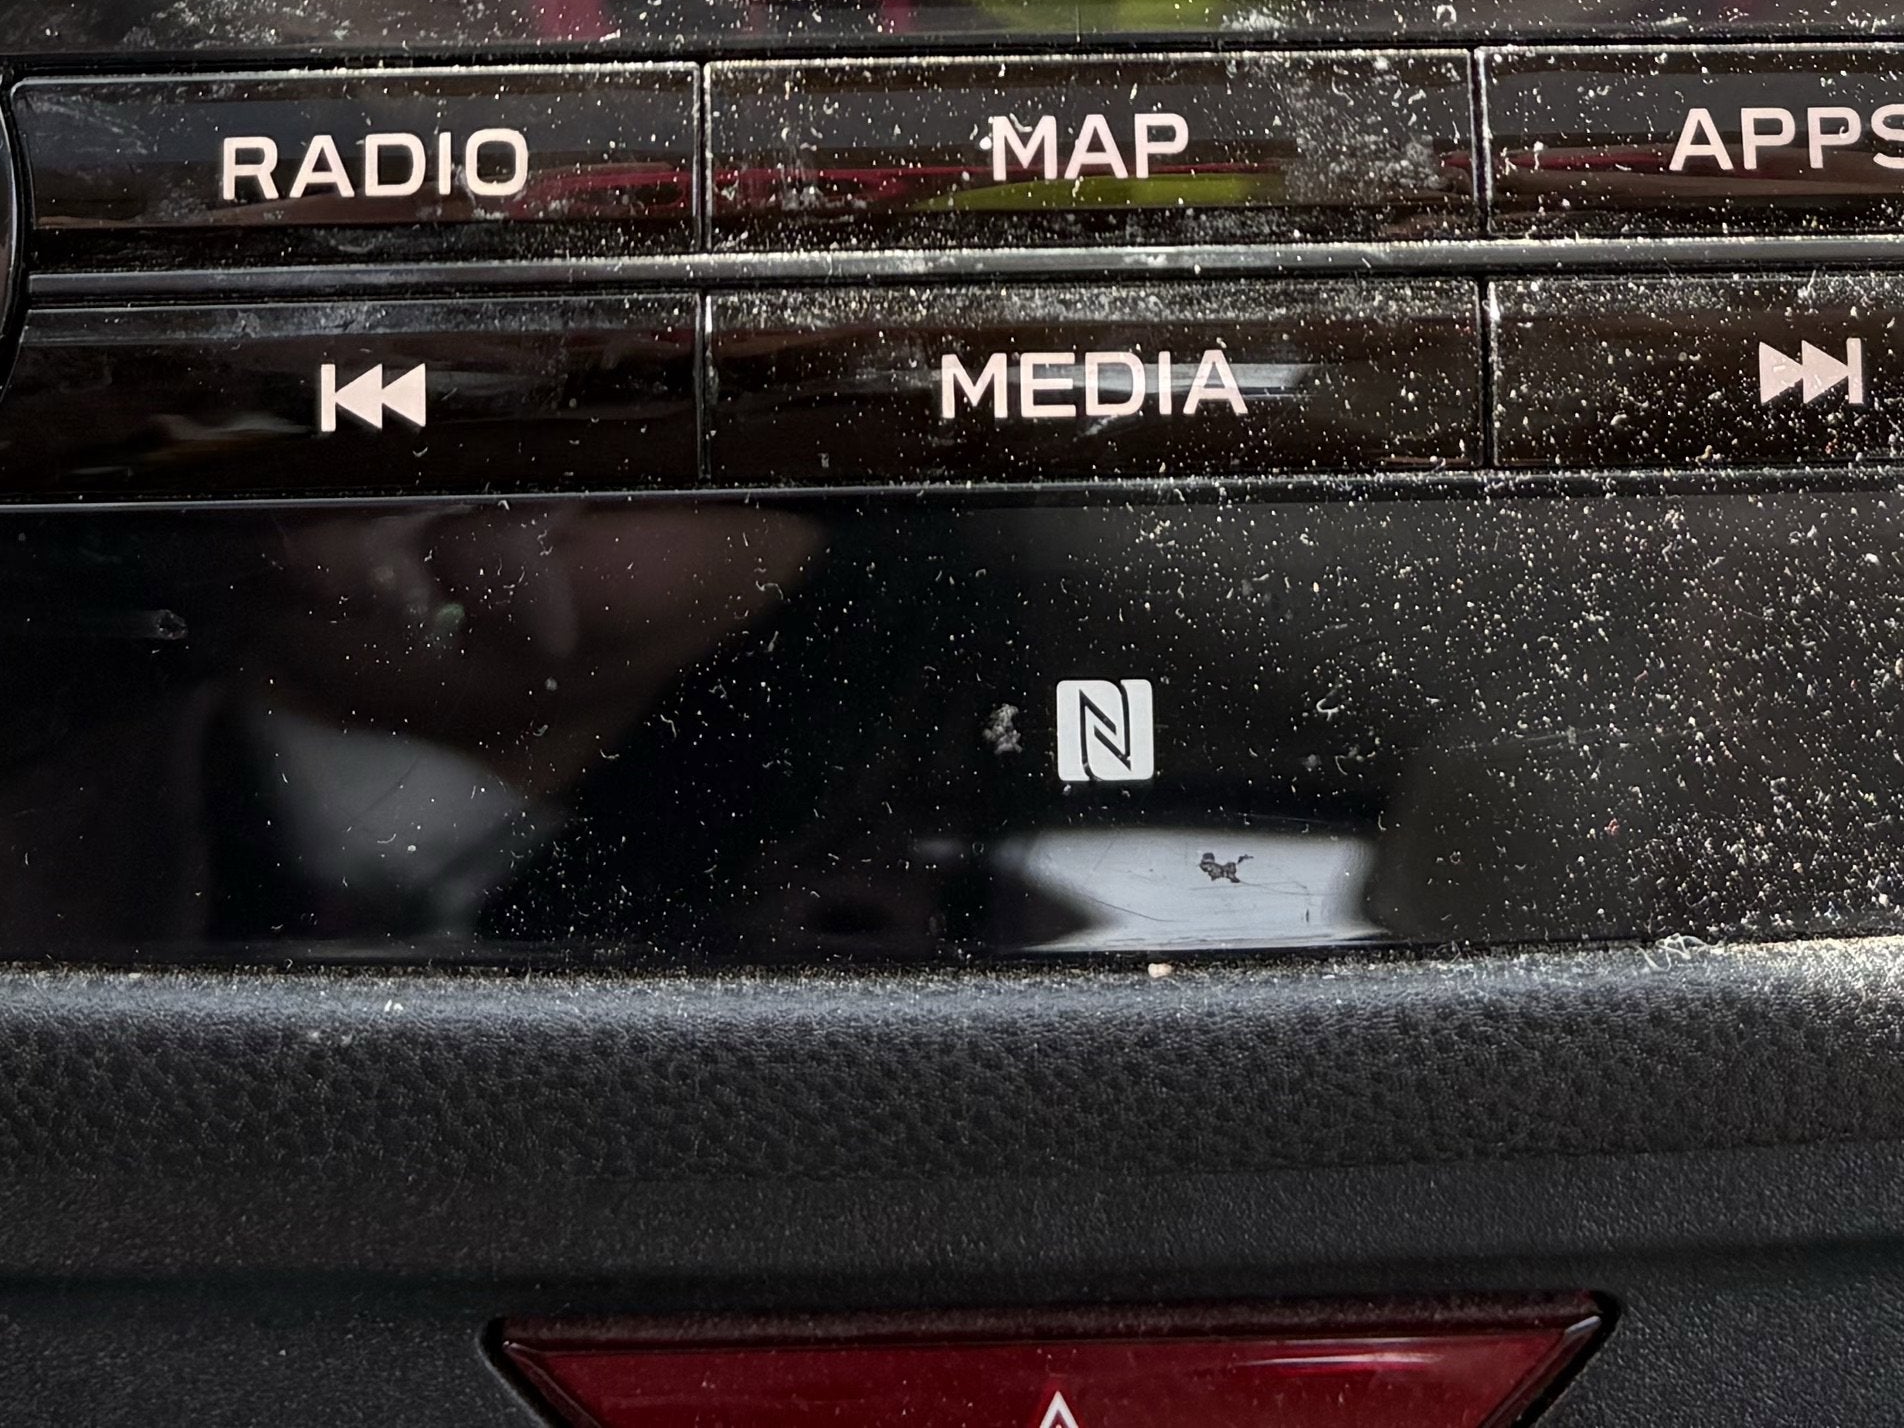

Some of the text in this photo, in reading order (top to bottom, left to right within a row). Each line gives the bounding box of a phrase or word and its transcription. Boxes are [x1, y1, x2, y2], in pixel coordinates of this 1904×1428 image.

[221, 126, 532, 201] RADIO
[992, 113, 1191, 180] MAP
[940, 349, 1248, 419] MEDIA
